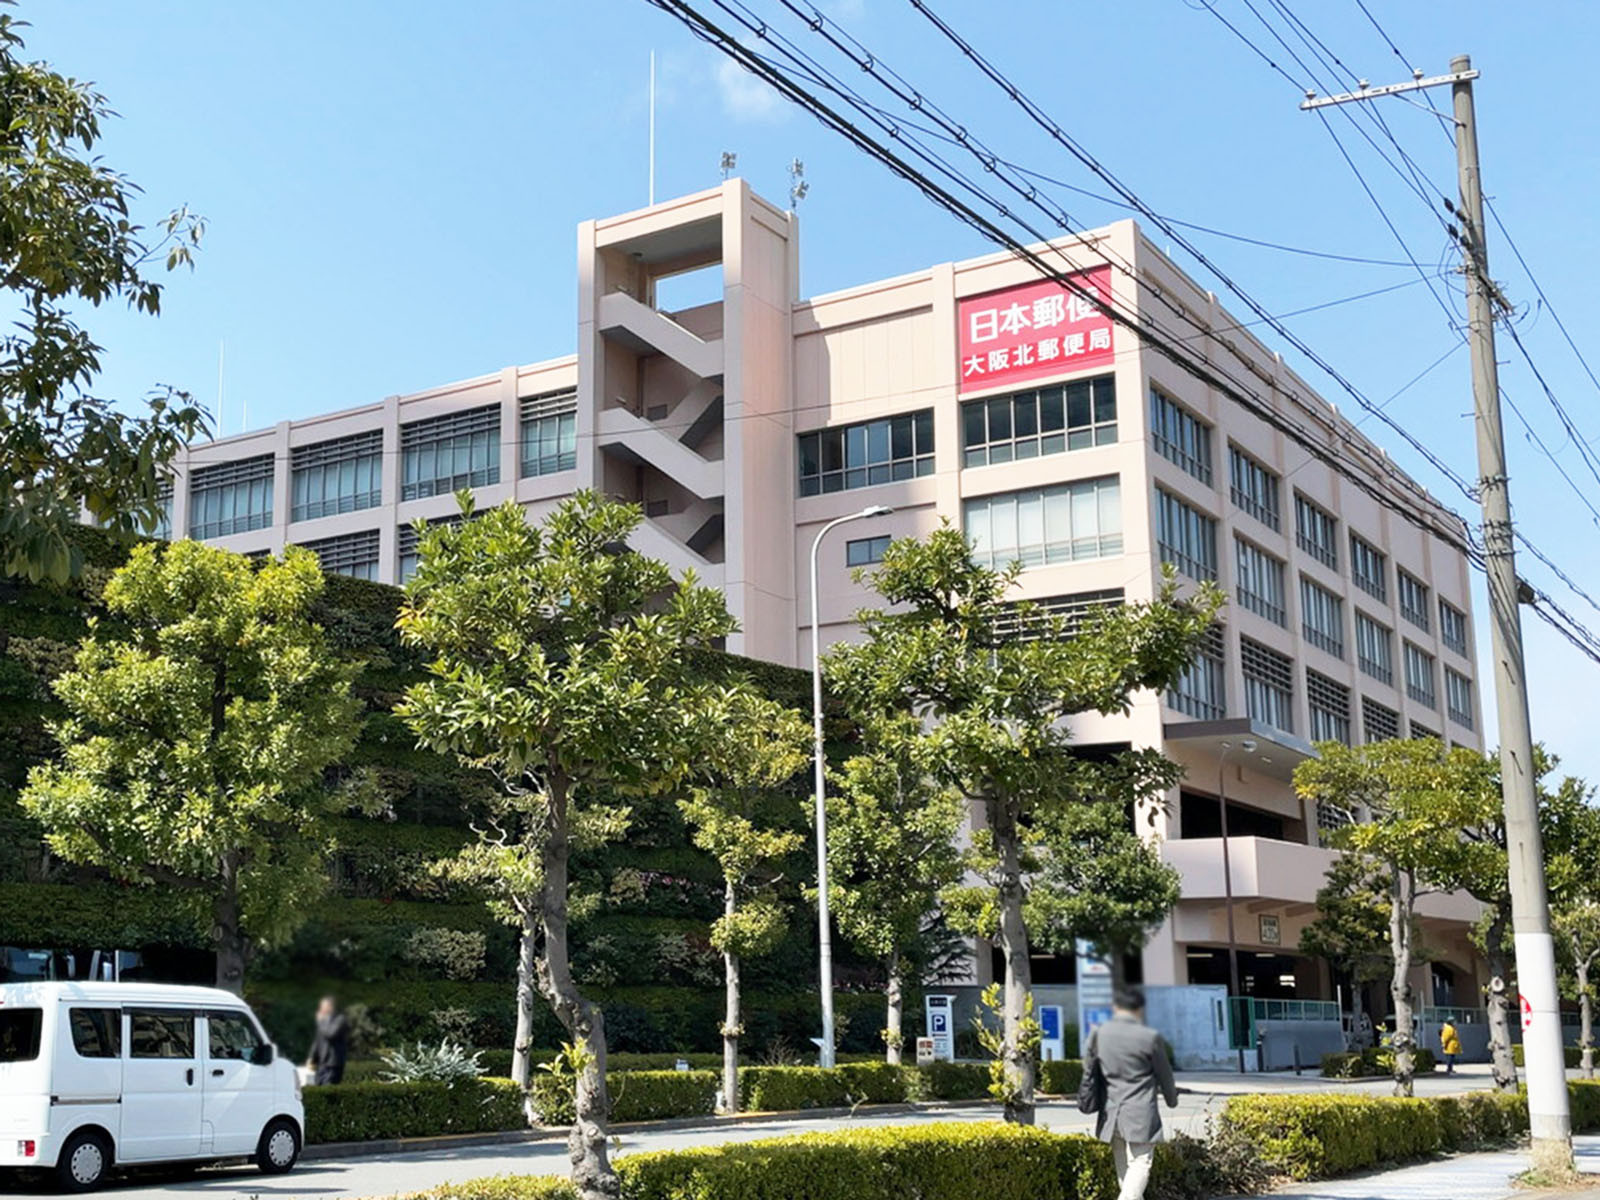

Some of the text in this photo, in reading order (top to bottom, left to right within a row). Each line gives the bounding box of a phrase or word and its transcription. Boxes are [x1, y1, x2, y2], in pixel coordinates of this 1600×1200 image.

[964, 328, 1111, 377] 大阪北郵便局
[933, 1016, 944, 1031] P
